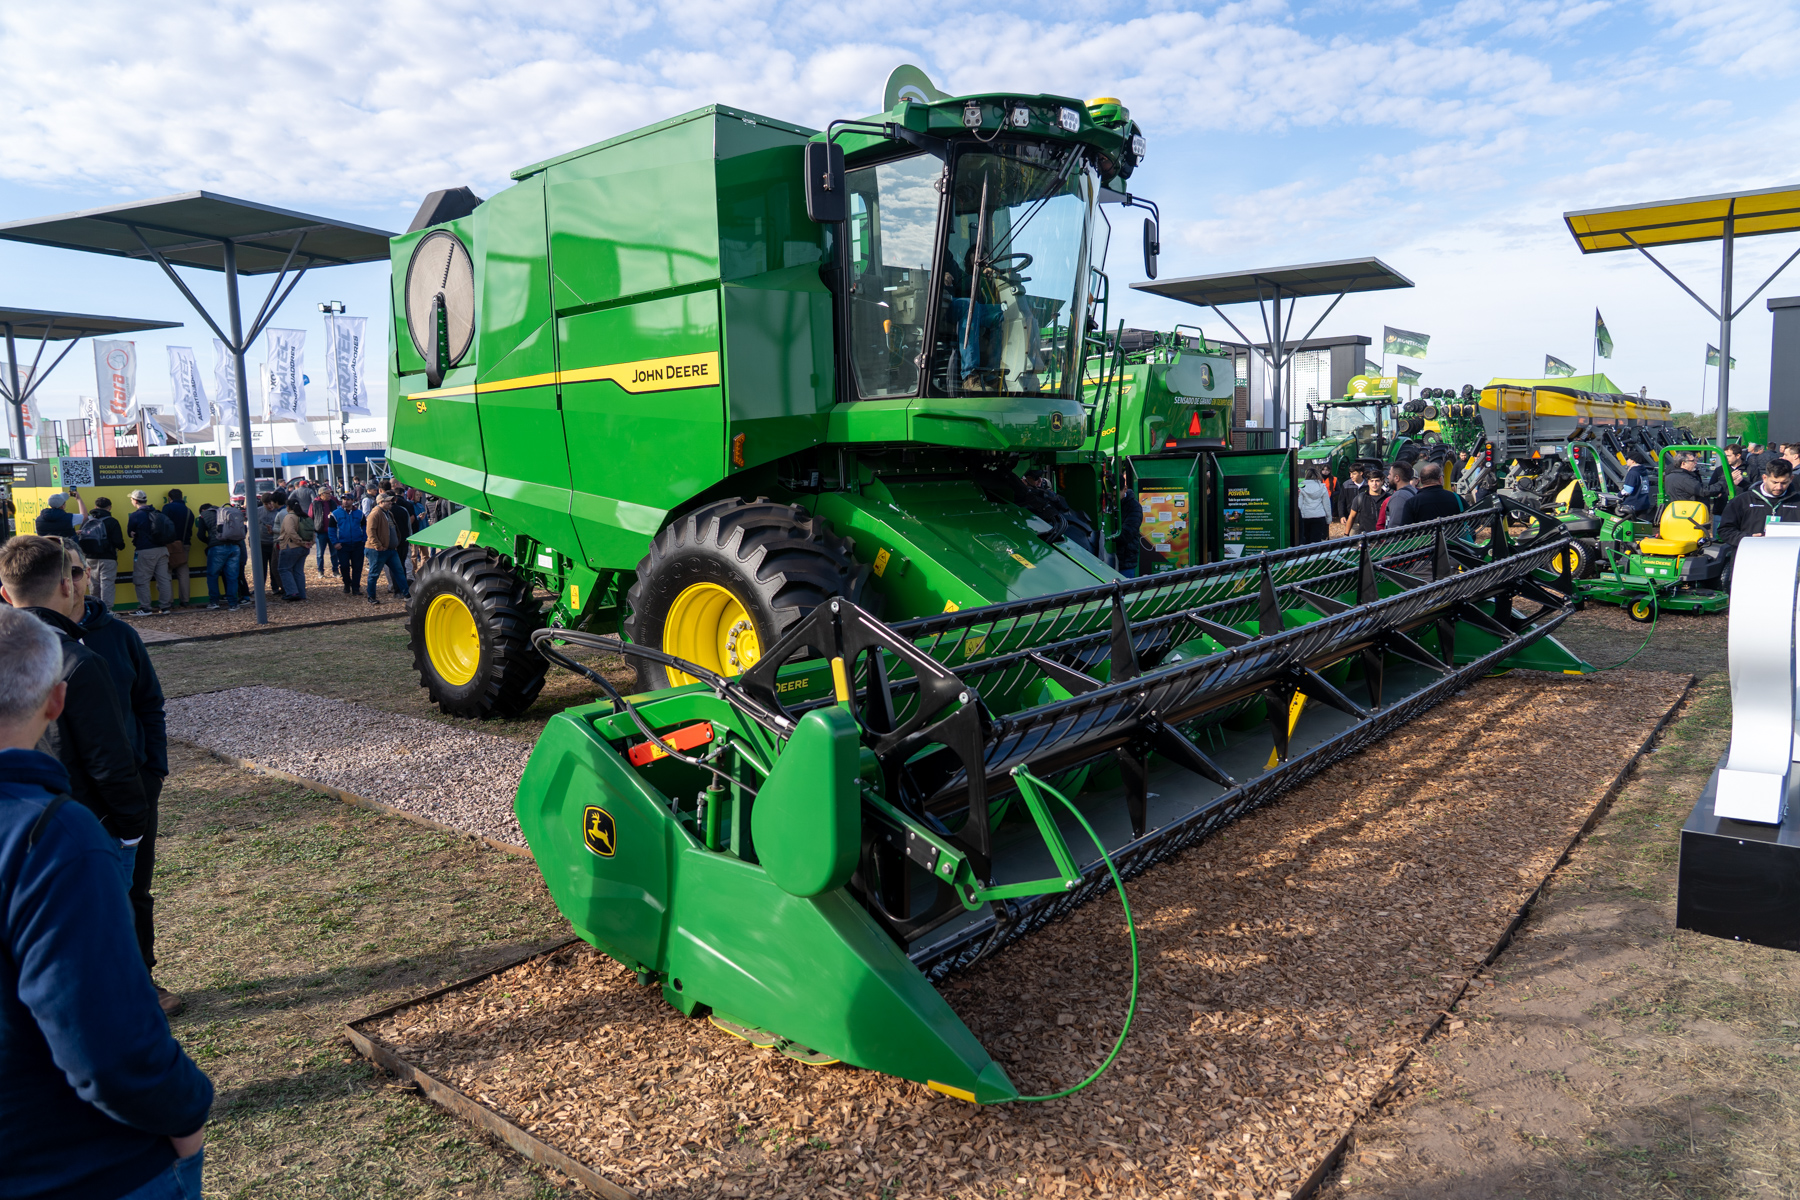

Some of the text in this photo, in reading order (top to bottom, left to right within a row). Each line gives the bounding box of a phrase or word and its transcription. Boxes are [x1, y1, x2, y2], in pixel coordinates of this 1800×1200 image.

[632, 364, 708, 383] JOHN DEERE
[776, 678, 809, 693] DEERE
